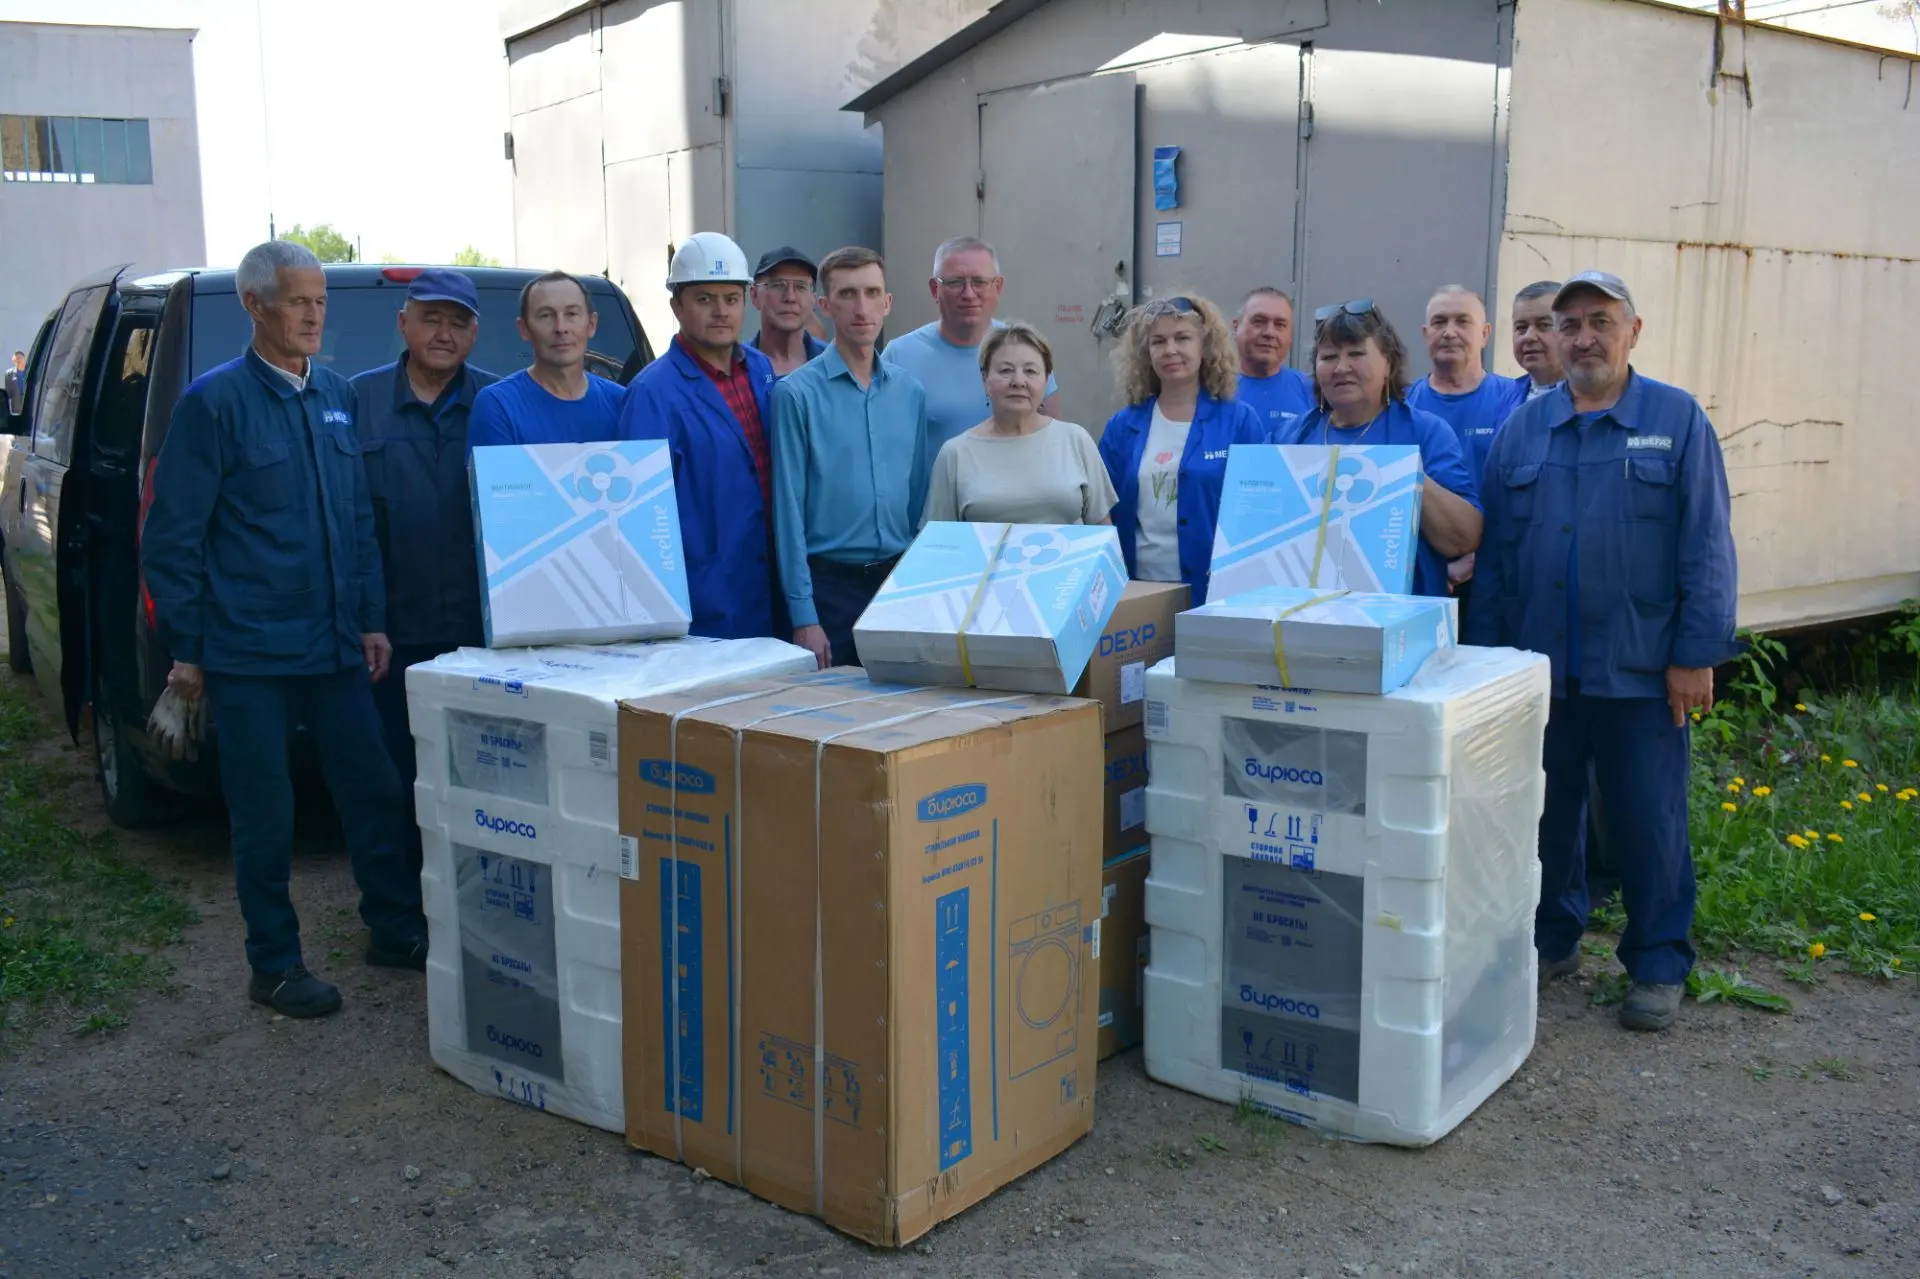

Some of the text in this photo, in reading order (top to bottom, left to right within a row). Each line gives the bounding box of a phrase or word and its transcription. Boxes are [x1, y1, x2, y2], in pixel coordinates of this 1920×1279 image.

[653, 504, 675, 571] aceline
[1378, 506, 1404, 570] aceline
[1052, 567, 1084, 610] aceline
[1100, 623, 1155, 657] DEXP
[1104, 750, 1148, 786] DEX
